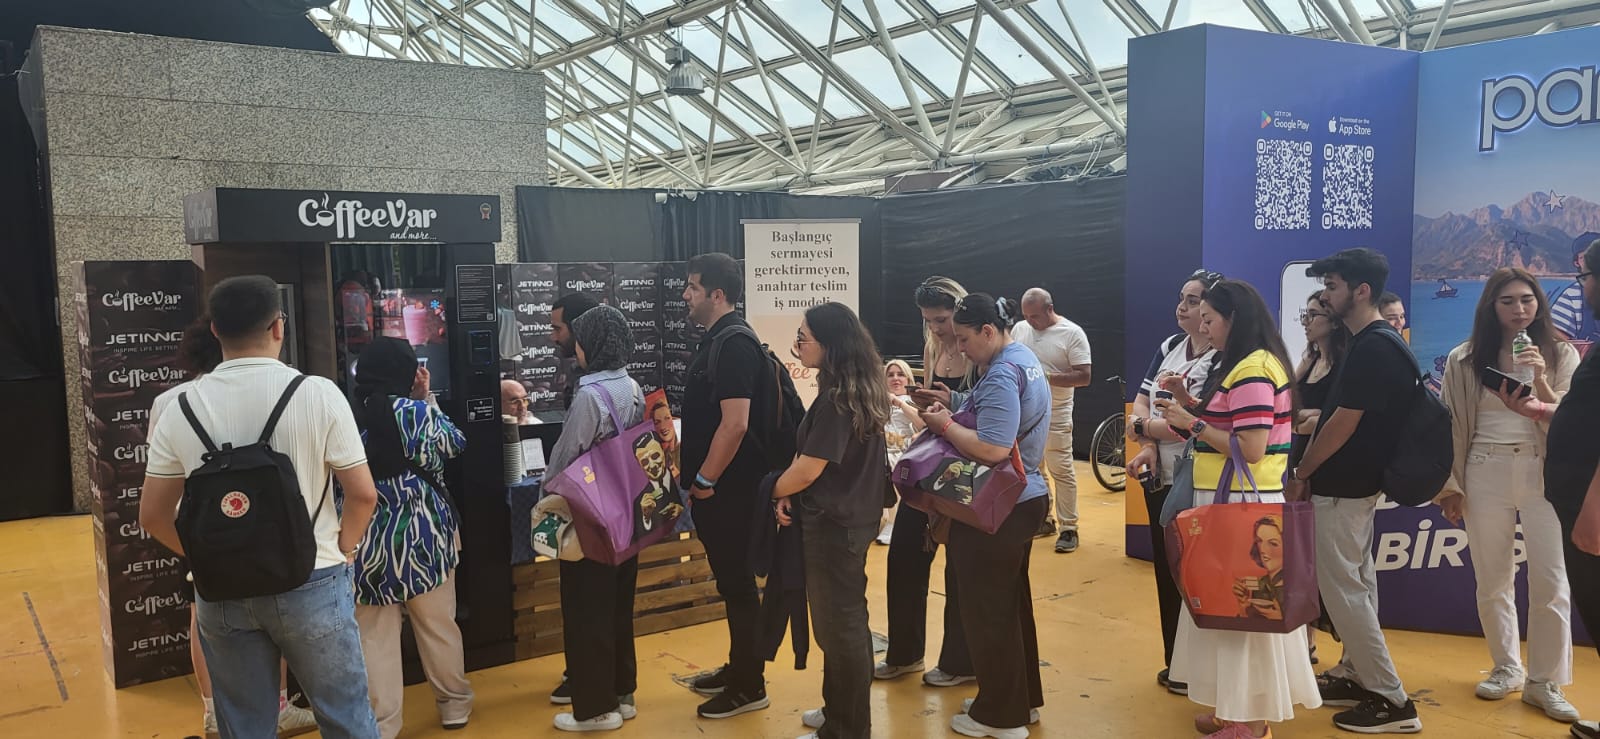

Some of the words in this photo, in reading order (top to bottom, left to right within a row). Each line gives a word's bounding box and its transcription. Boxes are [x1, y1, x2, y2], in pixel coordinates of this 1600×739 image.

[1479, 65, 1600, 152] pa
[1274, 118, 1296, 131] Google
[1297, 120, 1310, 132] Play
[1339, 124, 1353, 136] App
[1354, 125, 1372, 135] Store
[390, 226, 407, 239] and
[772, 231, 832, 244] Başlangıç
[770, 248, 833, 262] sermayesi
[754, 264, 850, 278] gerektirmeyen,
[757, 281, 806, 292] anahtar
[810, 280, 848, 291] teslim
[774, 296, 784, 310] iş
[112, 408, 149, 421] JETI
[125, 592, 184, 615] CoffeeV
[128, 630, 191, 651] JETINN
